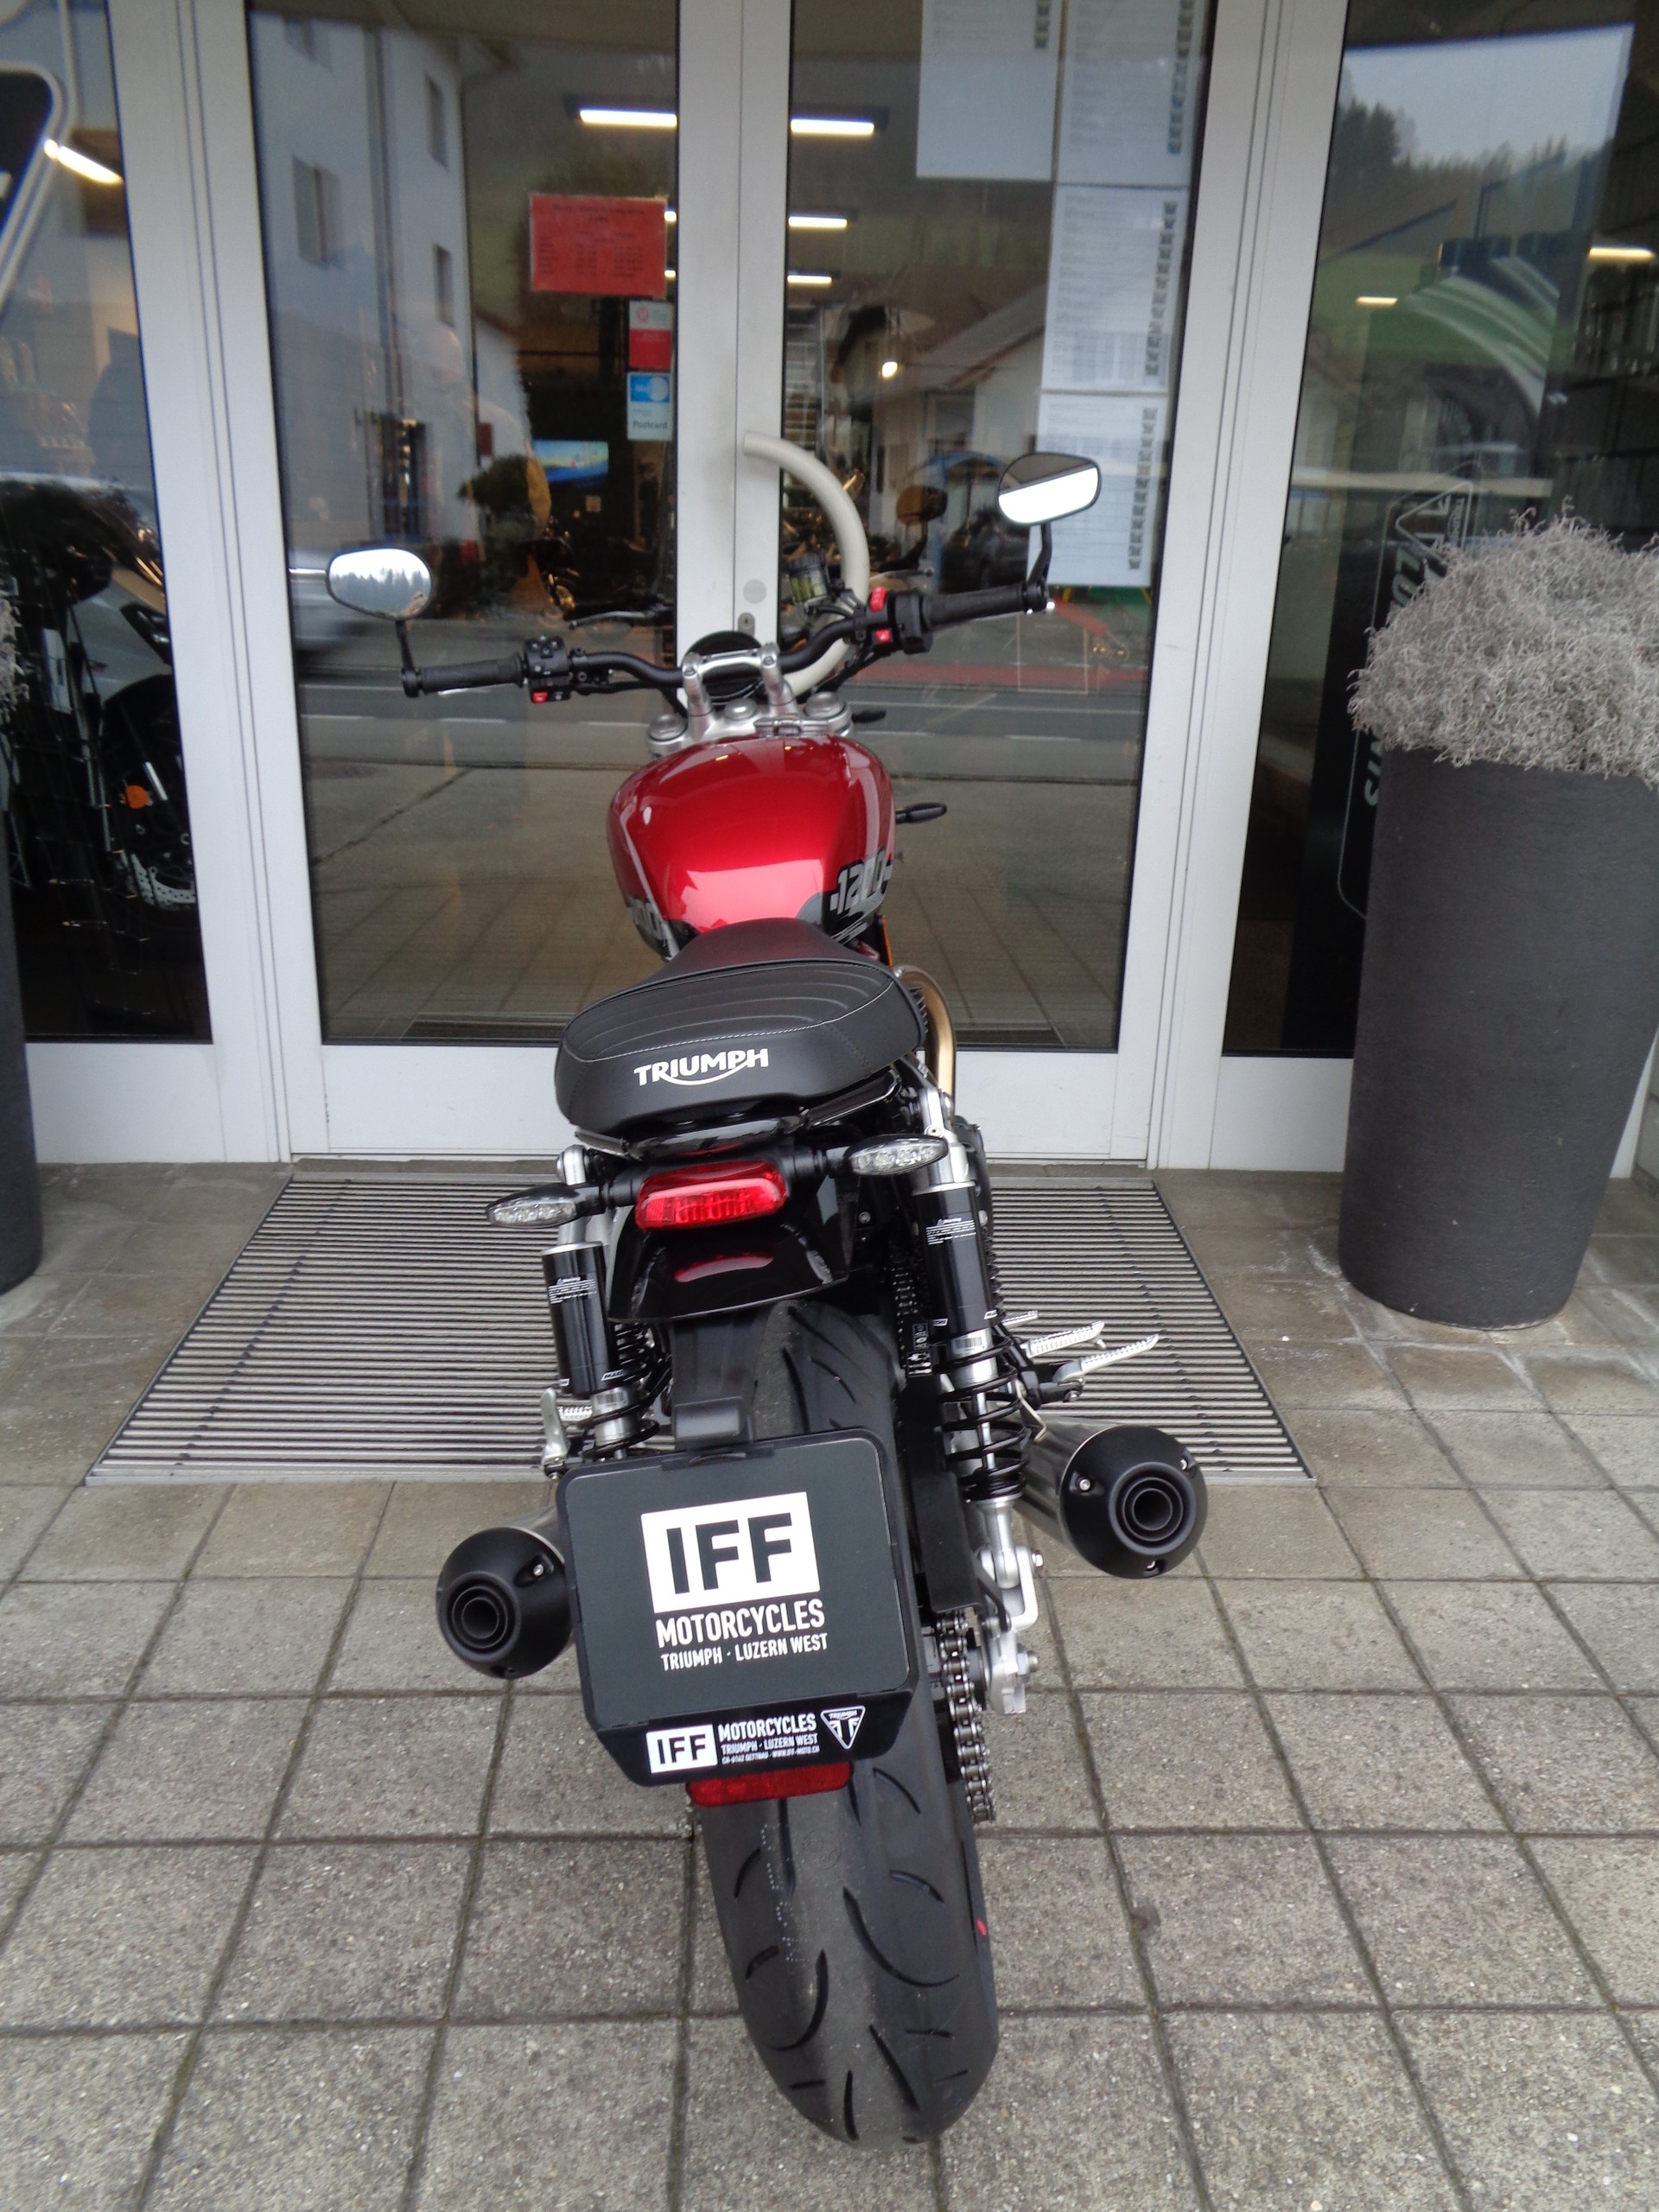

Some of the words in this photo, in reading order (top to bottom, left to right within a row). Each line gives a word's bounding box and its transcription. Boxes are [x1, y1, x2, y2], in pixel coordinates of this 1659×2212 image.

[633, 1048, 769, 1086] TRIUMPH
[666, 1512, 792, 1594] IFF
[655, 1599, 825, 1648] MOTORCYCLES
[660, 1646, 723, 1671] TRIUMPH
[734, 1636, 788, 1662] LUZERN
[790, 1632, 828, 1654] WEST
[657, 1733, 706, 1764] IFF
[717, 1713, 817, 1743] MOTORCYCLES
[721, 1742, 758, 1755] TRIUMPH
[763, 1736, 795, 1751] LUZERN
[795, 1732, 818, 1746] WEST
